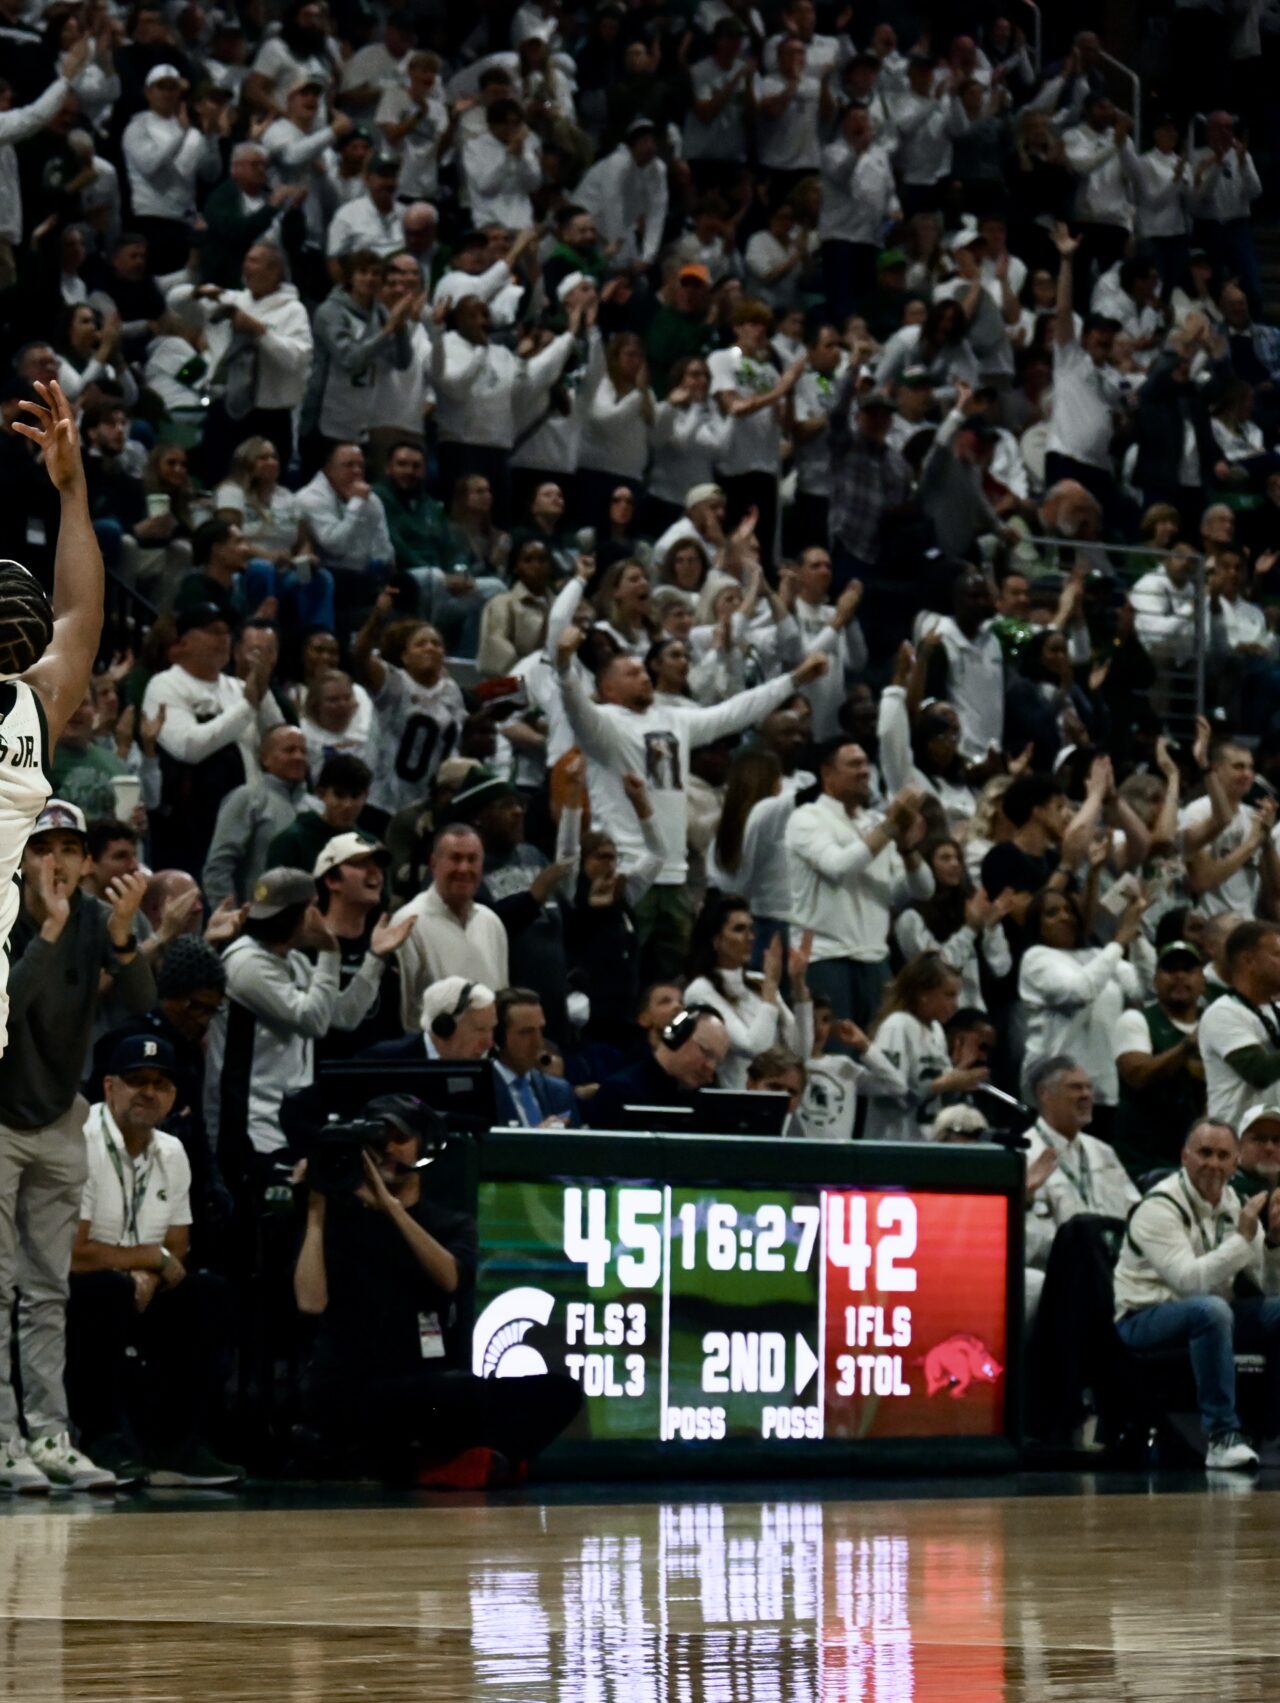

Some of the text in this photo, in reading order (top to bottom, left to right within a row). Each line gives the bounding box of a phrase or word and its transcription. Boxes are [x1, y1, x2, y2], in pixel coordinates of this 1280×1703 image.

[11, 735, 39, 768] JR.
[563, 1187, 662, 1289] 45
[679, 1202, 820, 1273] 16:27
[827, 1194, 918, 1292] 42
[701, 1331, 786, 1393] 2ND
[667, 1405, 726, 1440] POSS
[761, 1405, 820, 1440] POSS
